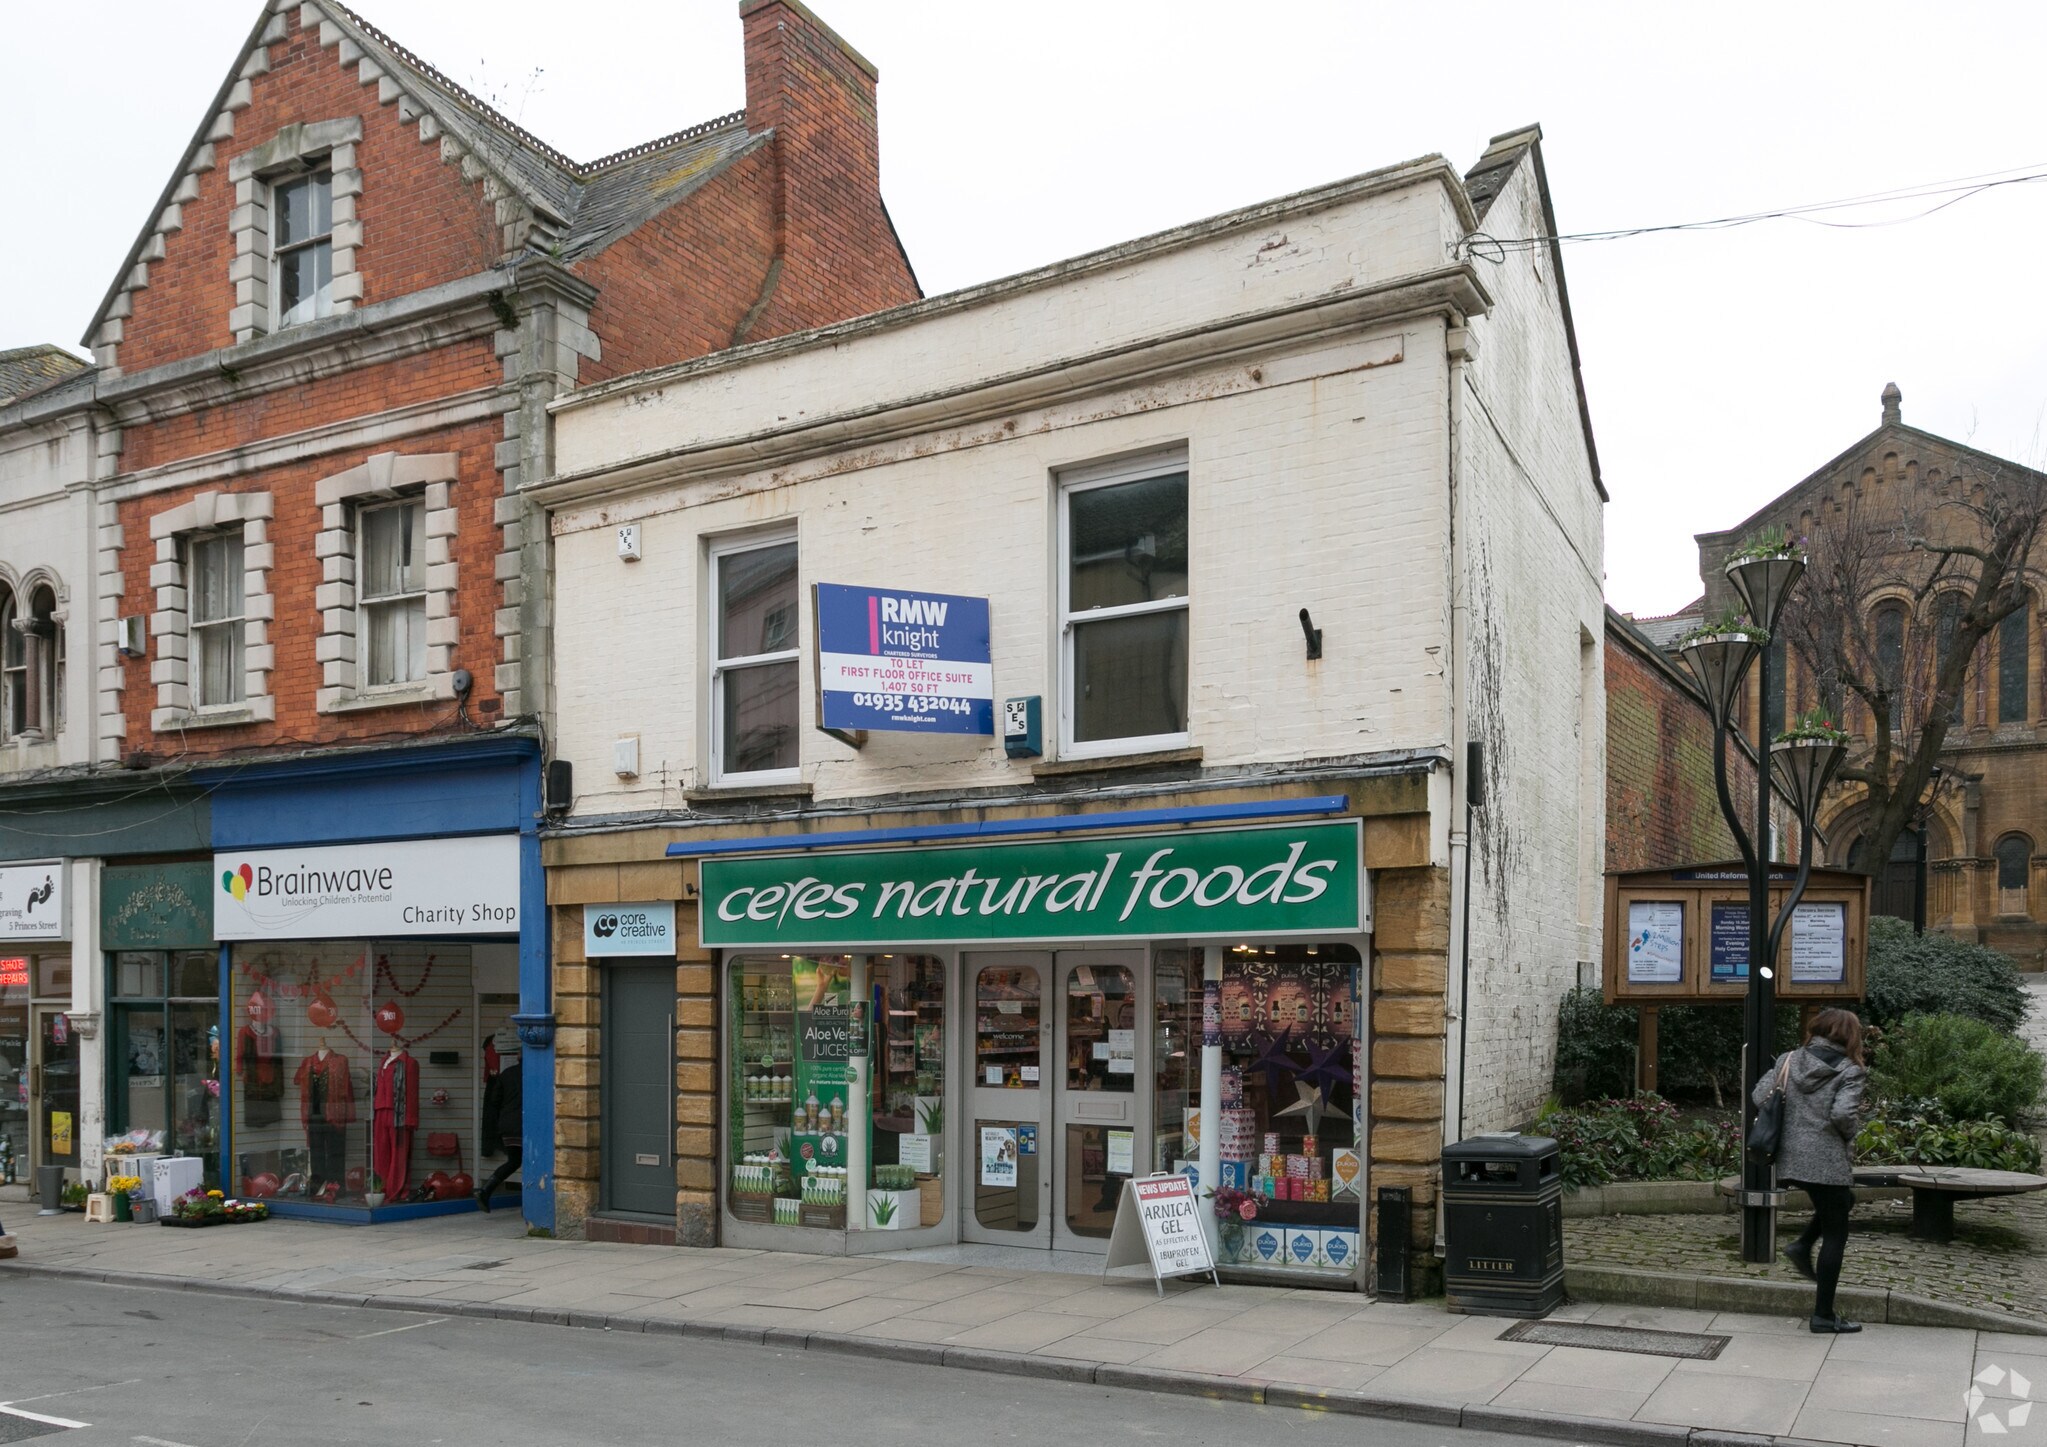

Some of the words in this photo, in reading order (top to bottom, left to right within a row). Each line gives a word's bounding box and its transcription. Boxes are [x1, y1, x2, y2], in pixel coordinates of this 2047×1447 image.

[881, 596, 948, 627] RMW
[882, 624, 940, 651] knight
[884, 650, 911, 658] CHARTERED
[910, 652, 938, 660] SURVEYORS
[891, 658, 904, 669] TO
[906, 660, 924, 670] LET
[841, 666, 869, 678] FIRST
[873, 669, 905, 680] FLOOR
[908, 671, 942, 682] OFFICE
[945, 673, 973, 684] SUITE
[881, 681, 907, 693] 1,407
[911, 683, 924, 694] SQ
[926, 685, 938, 694] FT
[853, 693, 904, 711] 01935
[908, 695, 971, 715] 432044
[891, 714, 937, 723] rmwknight.com
[257, 864, 393, 896] Brainwave
[717, 876, 866, 931] ceres
[872, 852, 1122, 919] natural
[1118, 840, 1338, 922] foods
[281, 896, 318, 908] Unlocking
[319, 895, 356, 905] Children's
[357, 892, 392, 903] Potential
[402, 904, 465, 925] Charity
[472, 903, 516, 924] Shop
[620, 913, 646, 926] core
[9, 922, 13, 931] 5
[15, 921, 38, 931] Princes
[39, 921, 58, 930] Street
[620, 922, 666, 938] creative
[814, 1006, 831, 1016] Aloe
[805, 1026, 831, 1040] Aloe
[813, 1043, 849, 1058] JUICES
[1336, 1160, 1358, 1168] pukka
[1159, 1180, 1188, 1194] UPDATE
[1145, 1202, 1193, 1220] ARNICA
[1161, 1220, 1184, 1235] GEL
[1163, 1236, 1189, 1244] EFFECTIVE
[1292, 1241, 1313, 1249] pukka
[1160, 1246, 1199, 1260] IBUPROFEN
[1176, 1259, 1189, 1268] GEL
[1469, 1260, 1513, 1271] LITTER
